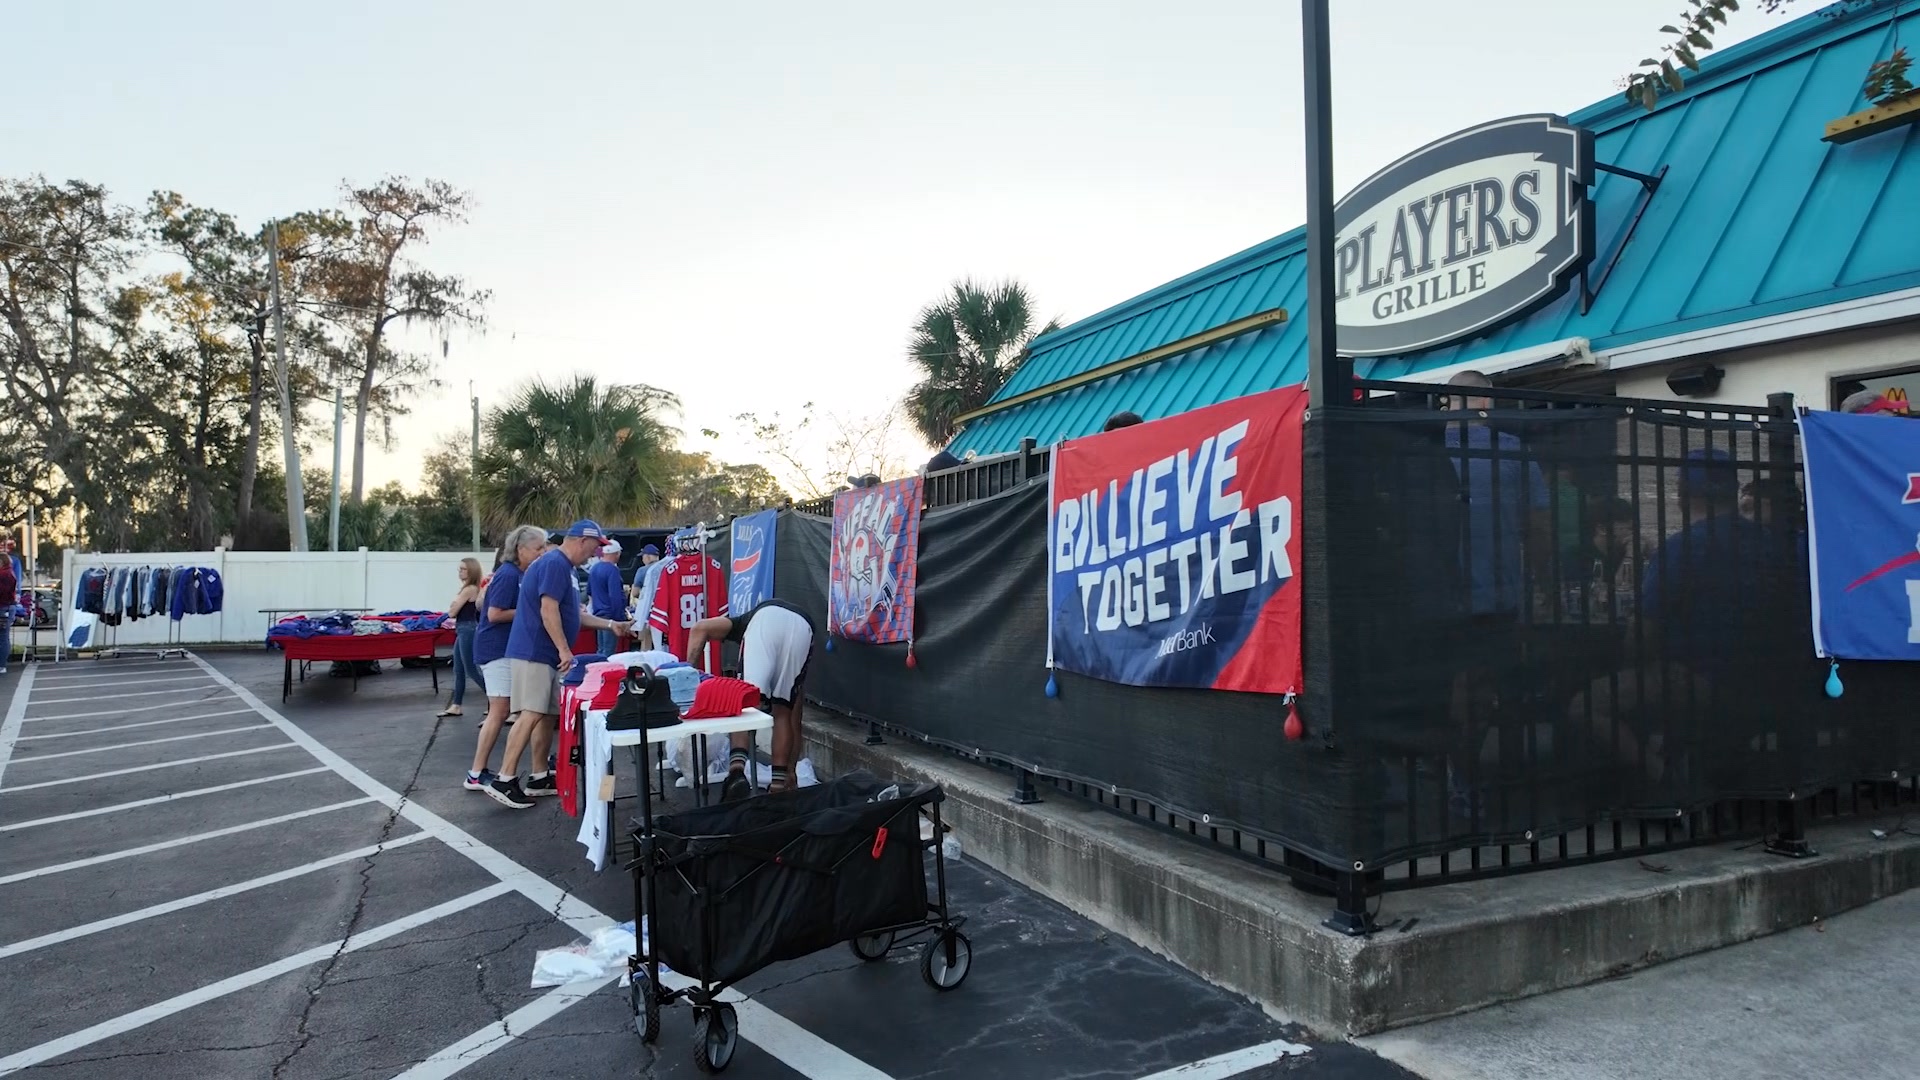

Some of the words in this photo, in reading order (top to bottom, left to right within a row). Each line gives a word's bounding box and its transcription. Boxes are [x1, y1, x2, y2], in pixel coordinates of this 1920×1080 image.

[1335, 170, 1541, 302] PLAYERS
[1372, 261, 1487, 320] GRILLE
[1056, 419, 1250, 573] BILLIEVE
[681, 573, 703, 587] KINCA
[1078, 495, 1293, 634] TOGETHER
[1177, 621, 1217, 652] Bank
